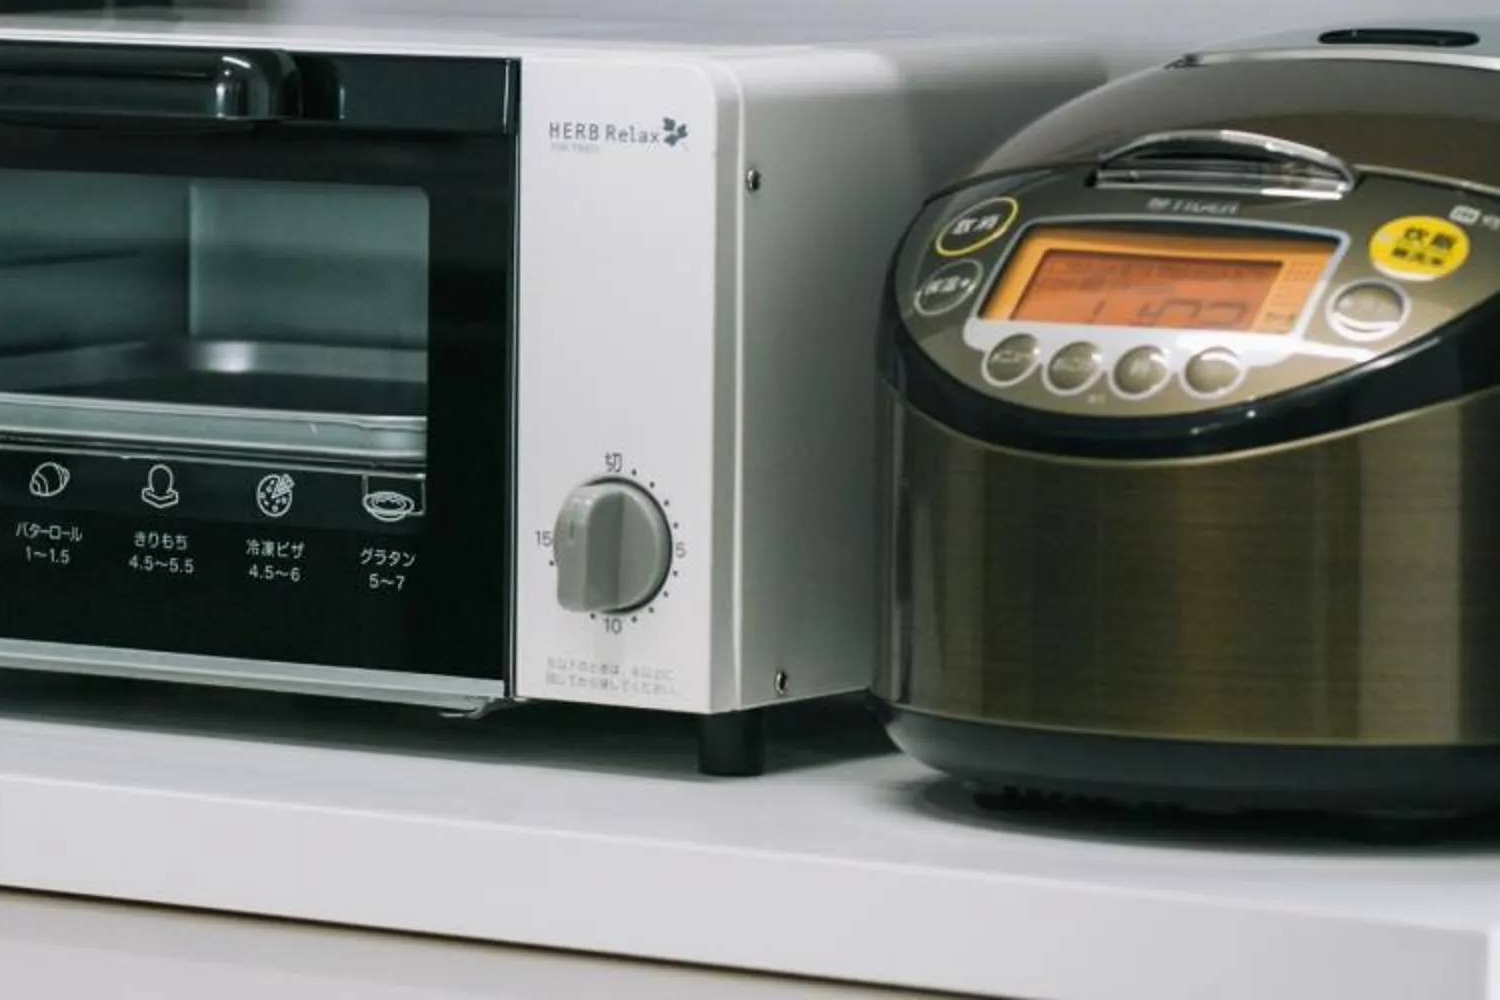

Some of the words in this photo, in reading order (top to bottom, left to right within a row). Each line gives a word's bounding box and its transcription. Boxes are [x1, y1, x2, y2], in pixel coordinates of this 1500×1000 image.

[549, 121, 599, 141] HERB
[605, 124, 659, 144] Relax
[605, 452, 623, 473] 切
[535, 529, 553, 547] 15
[359, 547, 416, 568] グラタン
[675, 541, 687, 559] 5
[603, 617, 623, 635] 10
